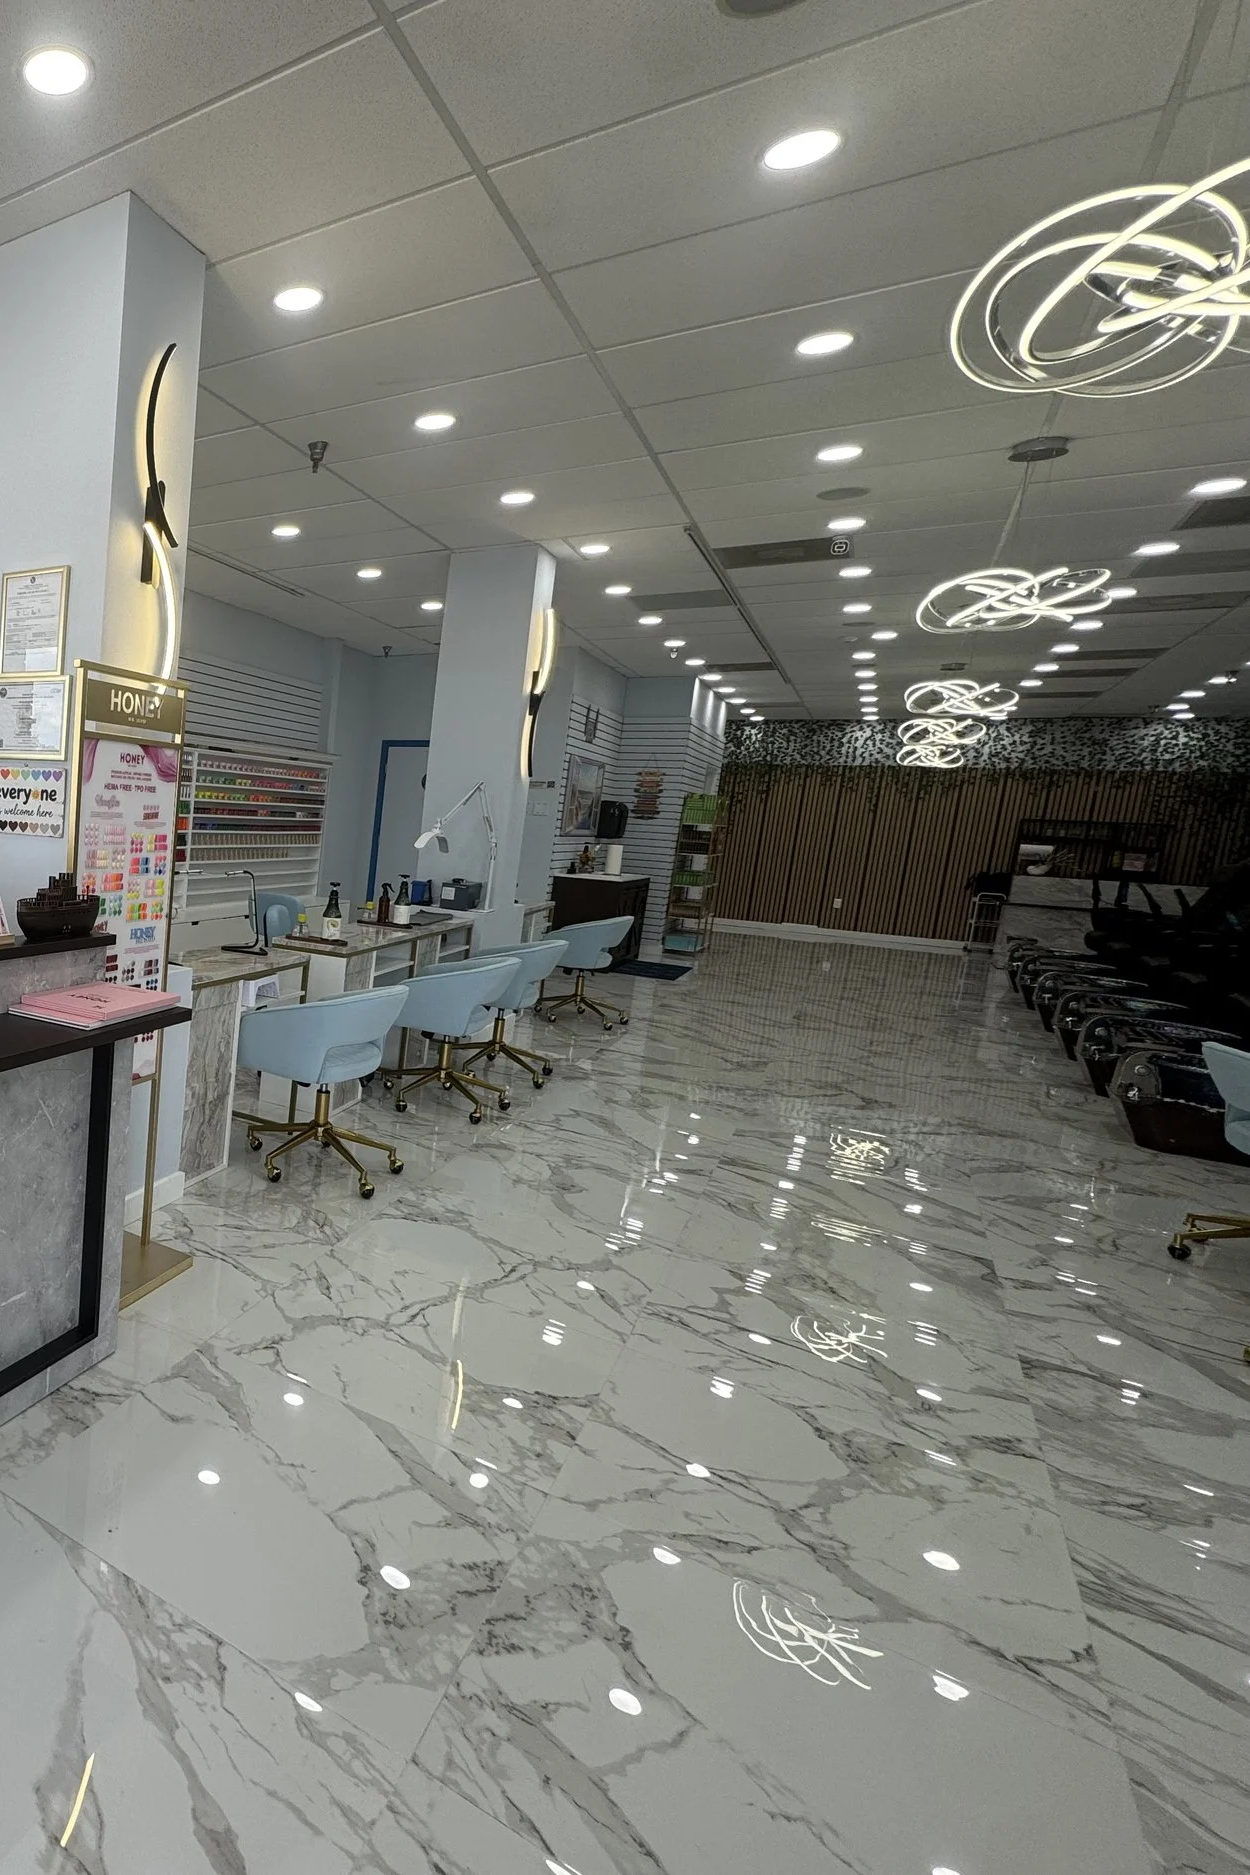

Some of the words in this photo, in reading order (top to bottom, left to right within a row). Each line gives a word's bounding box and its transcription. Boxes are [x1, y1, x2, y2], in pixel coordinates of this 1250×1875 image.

[110, 688, 164, 719] HONEY
[120, 752, 145, 765] HONEY
[4, 803, 35, 816] welcome
[36, 804, 53, 818] here
